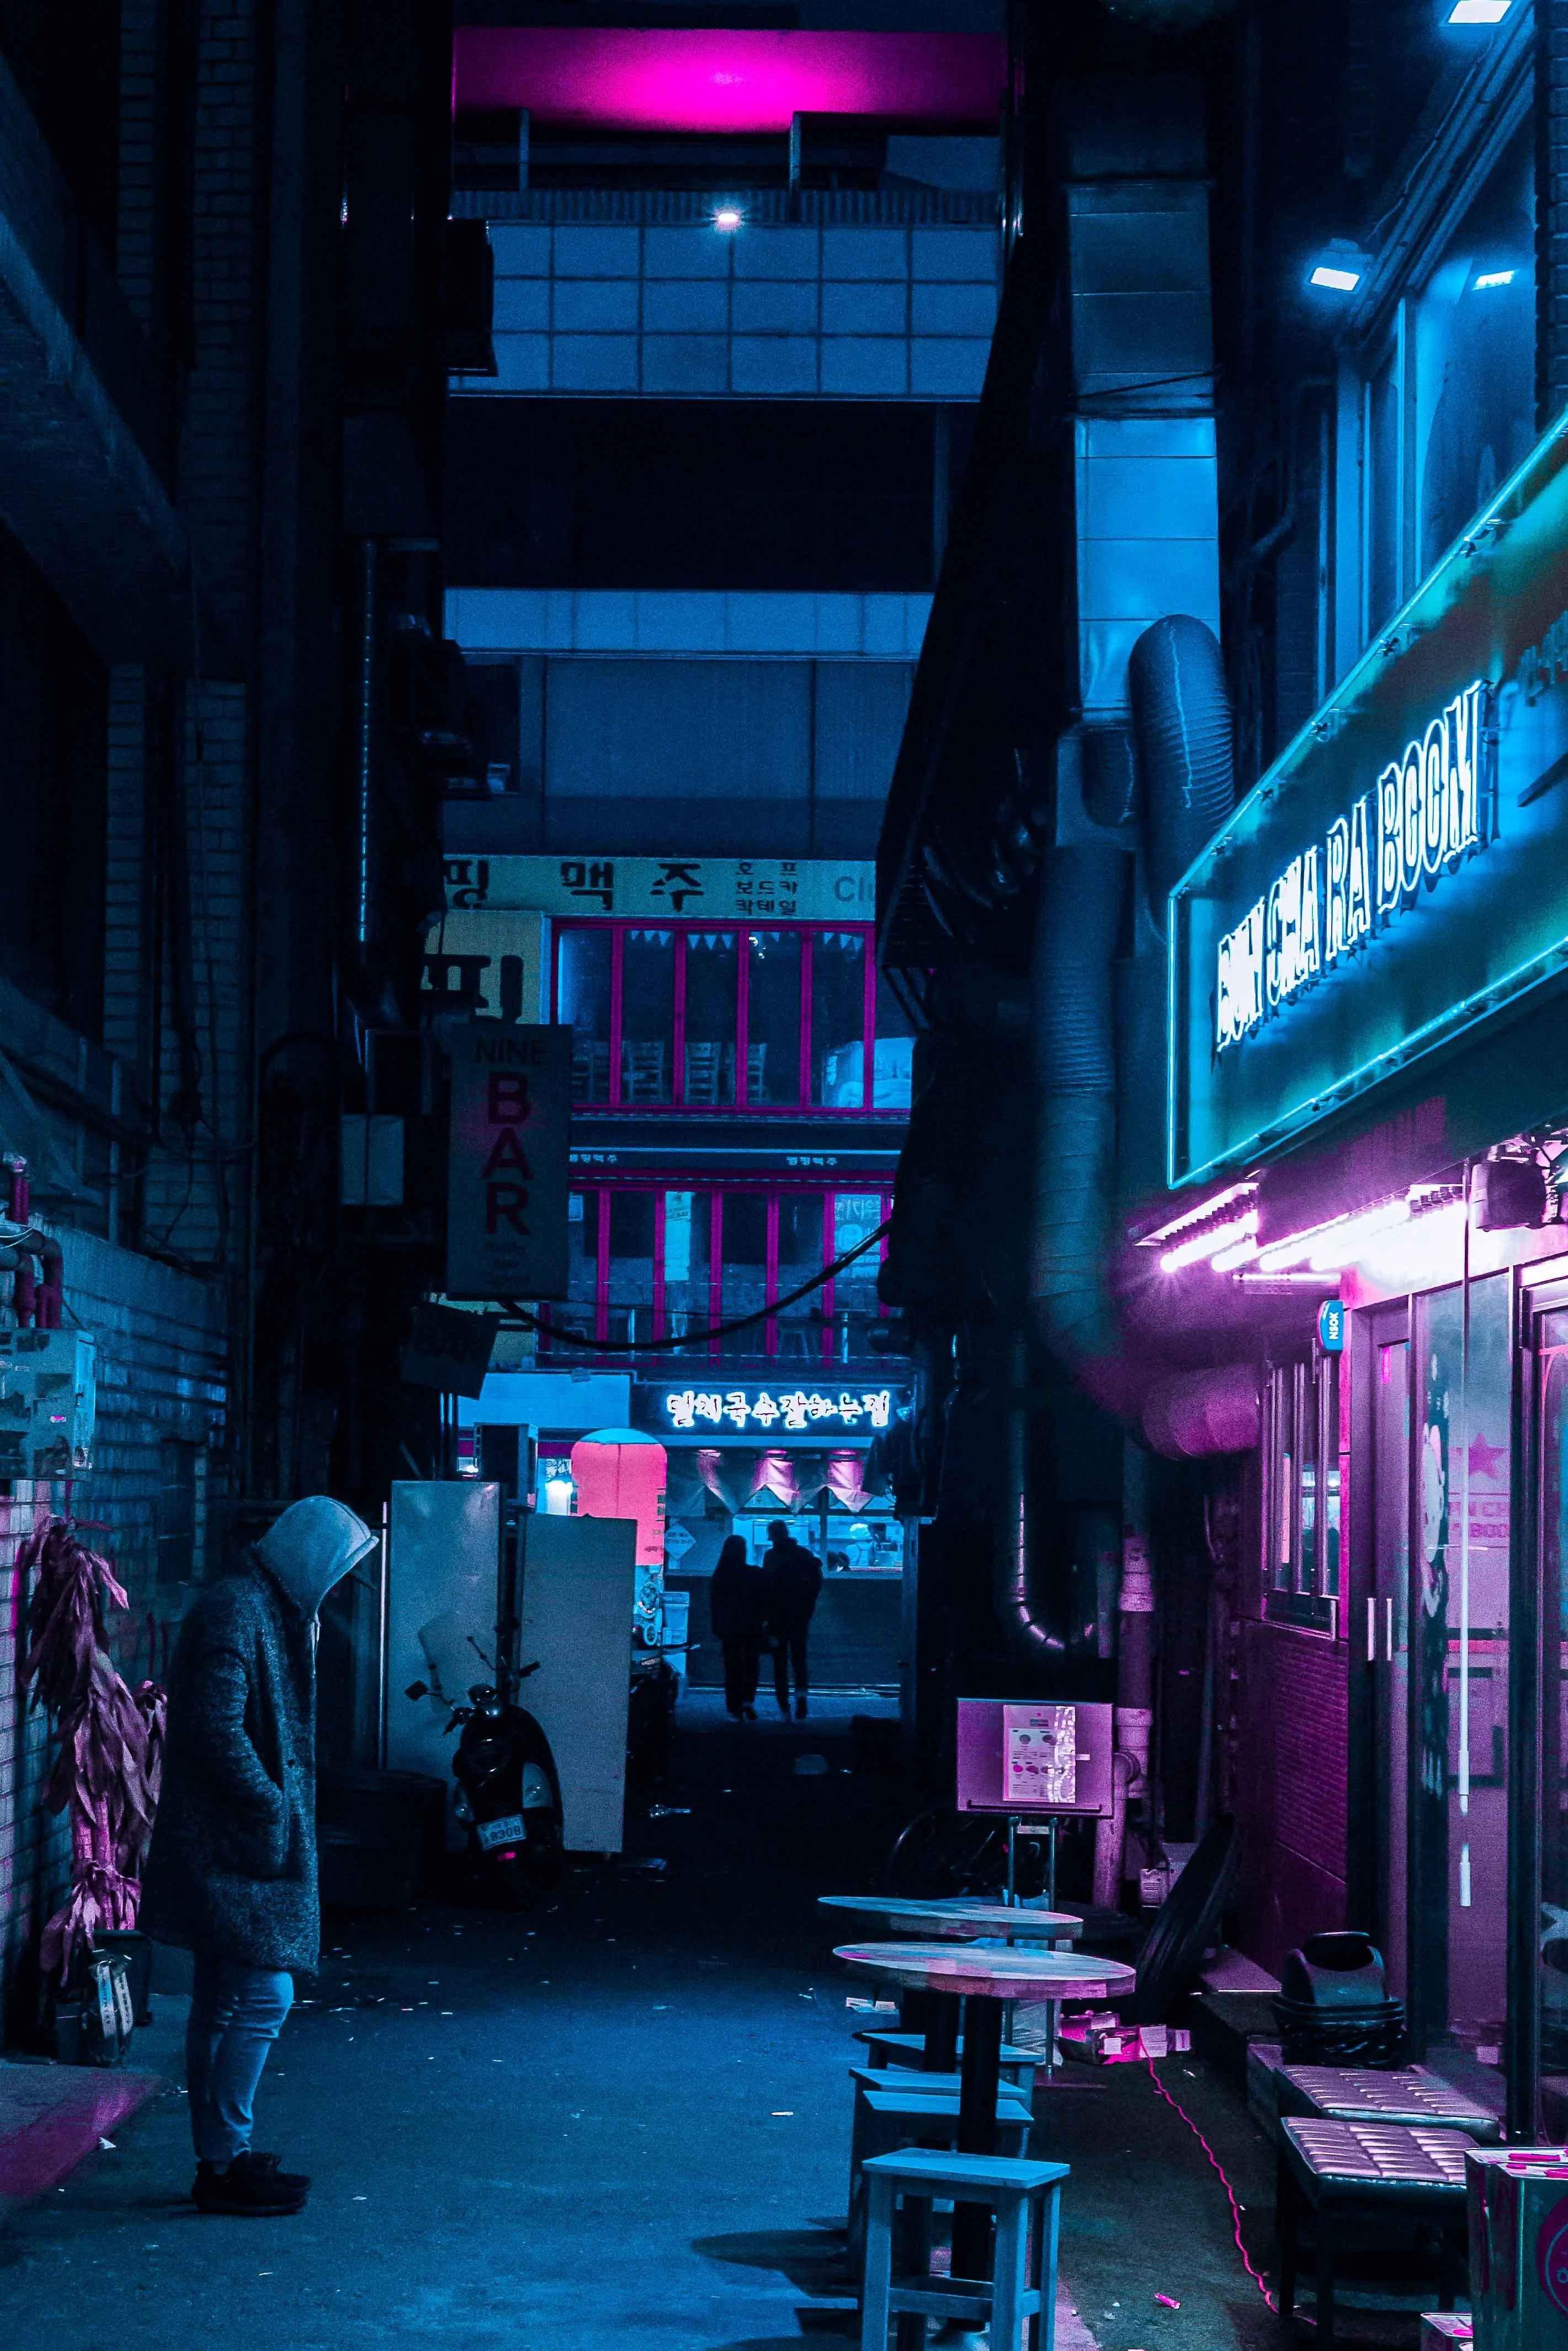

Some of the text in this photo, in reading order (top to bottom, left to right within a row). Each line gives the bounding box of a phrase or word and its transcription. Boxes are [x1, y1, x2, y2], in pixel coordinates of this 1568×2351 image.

[1326, 794, 1370, 962] RA
[1377, 679, 1480, 915] BOOM
[736, 881, 799, 895] 보드카
[475, 1037, 545, 1065] NINE
[482, 1071, 533, 1235] BAR
